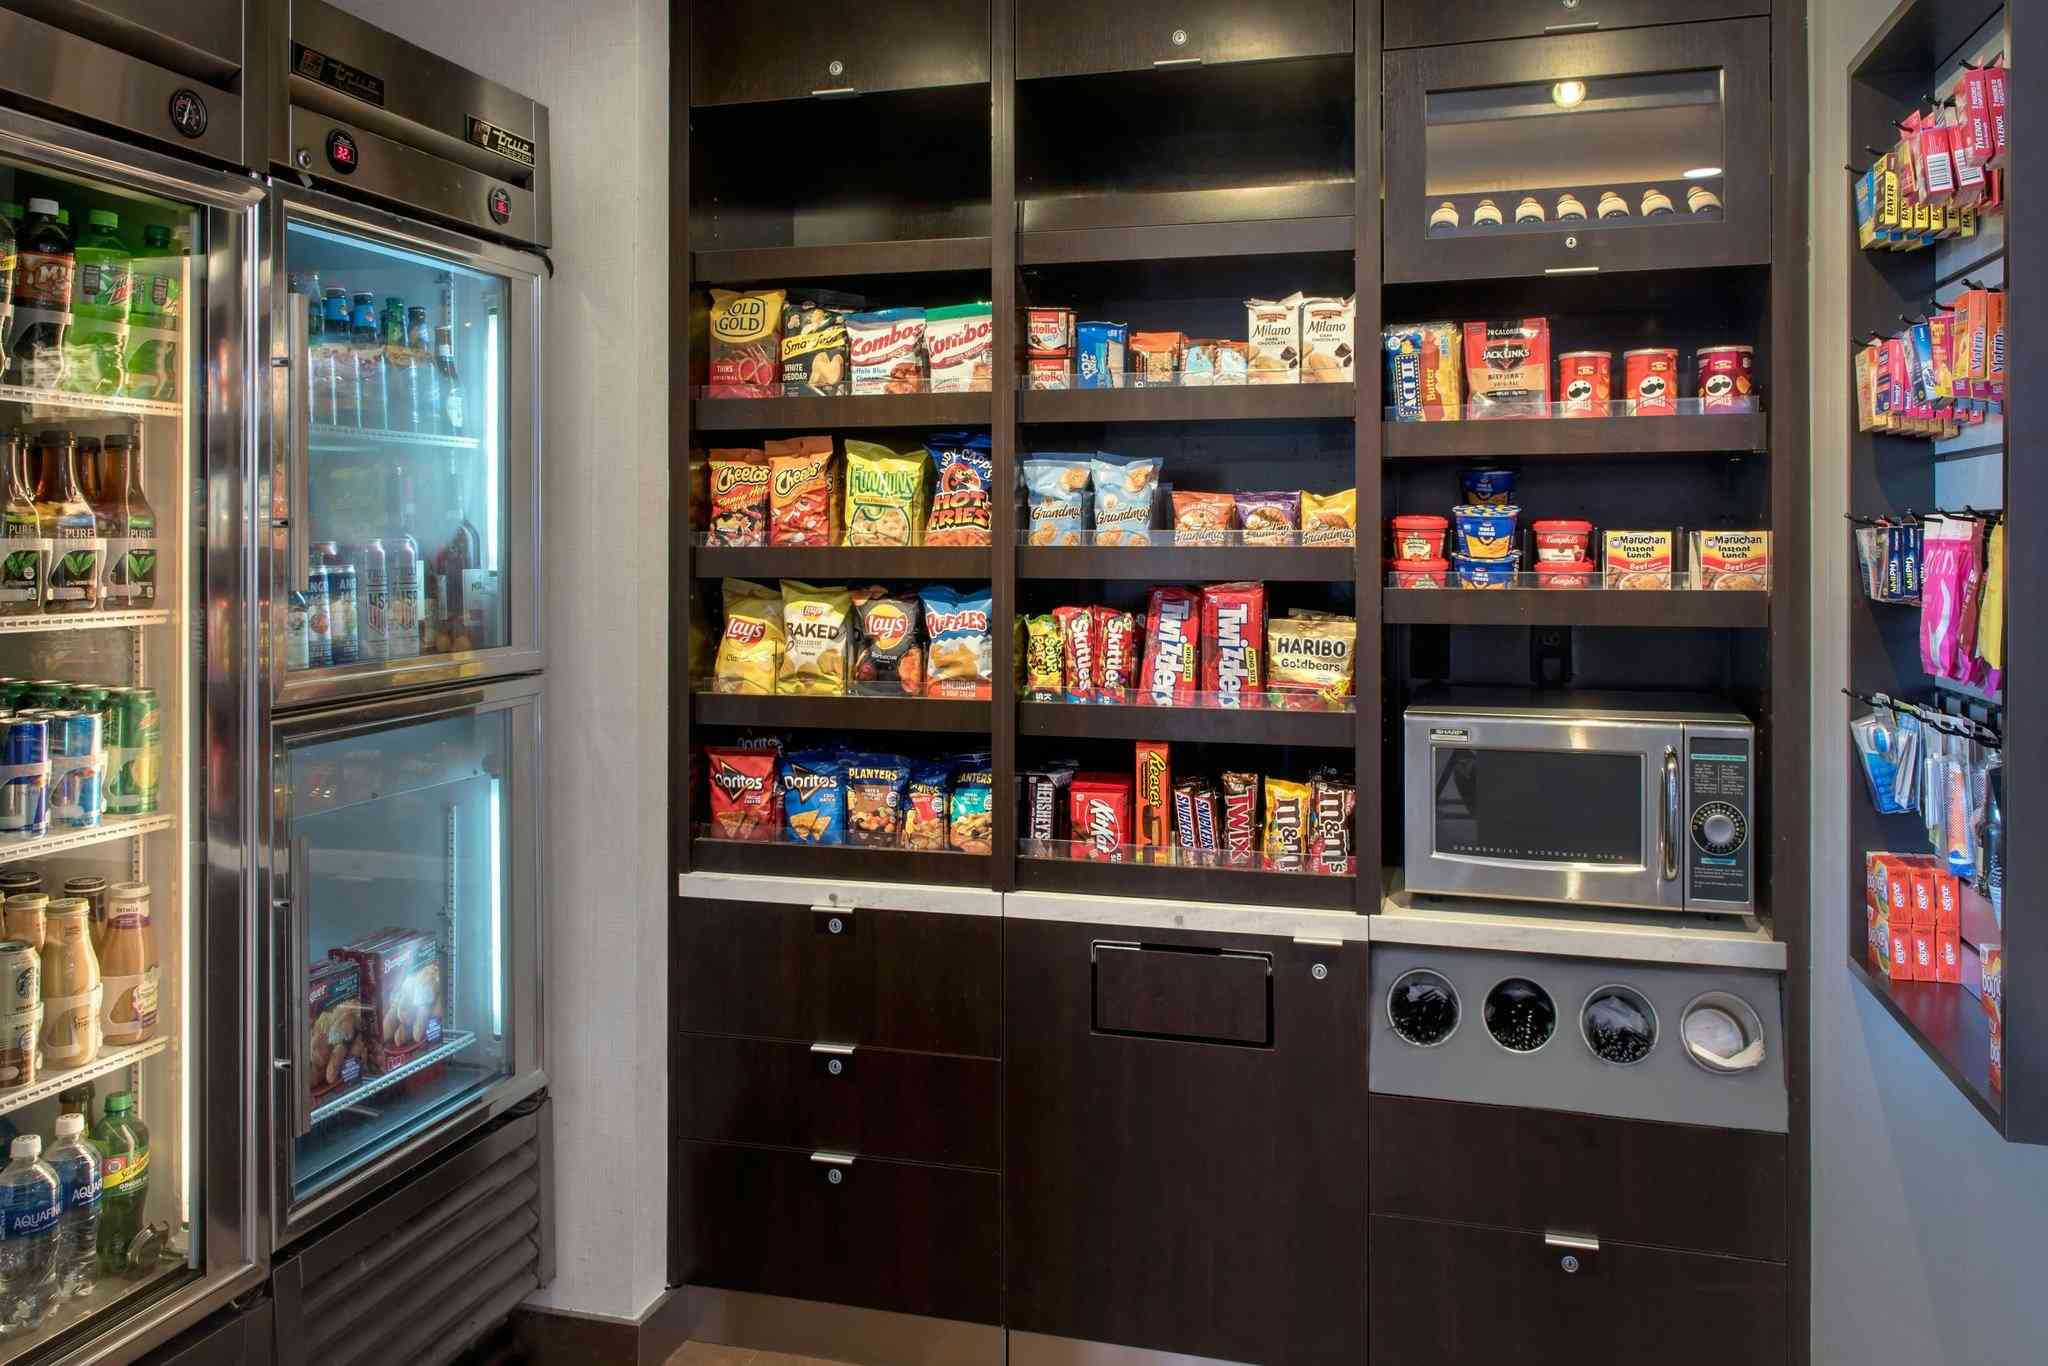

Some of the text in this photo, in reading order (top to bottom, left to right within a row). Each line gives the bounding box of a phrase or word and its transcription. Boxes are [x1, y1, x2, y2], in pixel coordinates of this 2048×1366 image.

[492, 129, 531, 155] true
[497, 144, 533, 164] FREEZER
[1886, 183, 1896, 217] BAYER
[719, 317, 760, 332] GOLD
[1030, 324, 1058, 335] utella
[1252, 324, 1292, 338] Milano
[1307, 320, 1347, 335] Milano
[851, 323, 924, 356] Combos
[784, 363, 804, 373] WHITE
[1400, 360, 1418, 410] ACT II
[717, 464, 771, 494] Cheetos
[935, 491, 986, 508] HOT
[931, 506, 991, 530] FRIES
[9, 524, 36, 536] PURE
[65, 528, 96, 539] PURE
[130, 529, 153, 540] PURE
[1620, 535, 1666, 545] Maruchan
[1715, 535, 1762, 545] Maruchan
[1623, 544, 1655, 552] Instant
[1718, 544, 1751, 552] Instant
[1629, 562, 1648, 570] Beef
[1724, 562, 1744, 571] Beef
[726, 617, 766, 643] Lay's
[786, 622, 840, 640] BAKED
[868, 614, 905, 638] Lay's
[926, 610, 988, 638] RUFFLES
[1035, 634, 1047, 676] PATCH
[1045, 636, 1058, 673] SOUR
[1071, 620, 1092, 691] Skittles
[1151, 600, 1190, 707] Twizzlers
[1278, 637, 1347, 658] HARIBO
[1281, 658, 1343, 674] Goldbears
[715, 773, 764, 791] Doritos
[783, 774, 838, 791] Doritos
[848, 767, 899, 782] PLANTERS
[1149, 750, 1168, 808] Reese's
[1035, 782, 1054, 840] HERSHEY'S
[1176, 792, 1194, 849] SNICKERS
[1089, 799, 1117, 854] KitKat
[1196, 799, 1215, 850] SNICKERS
[1225, 789, 1256, 863] TWIX
[1318, 790, 1349, 873] m&m's
[14, 1203, 60, 1231] AQUAFIN
